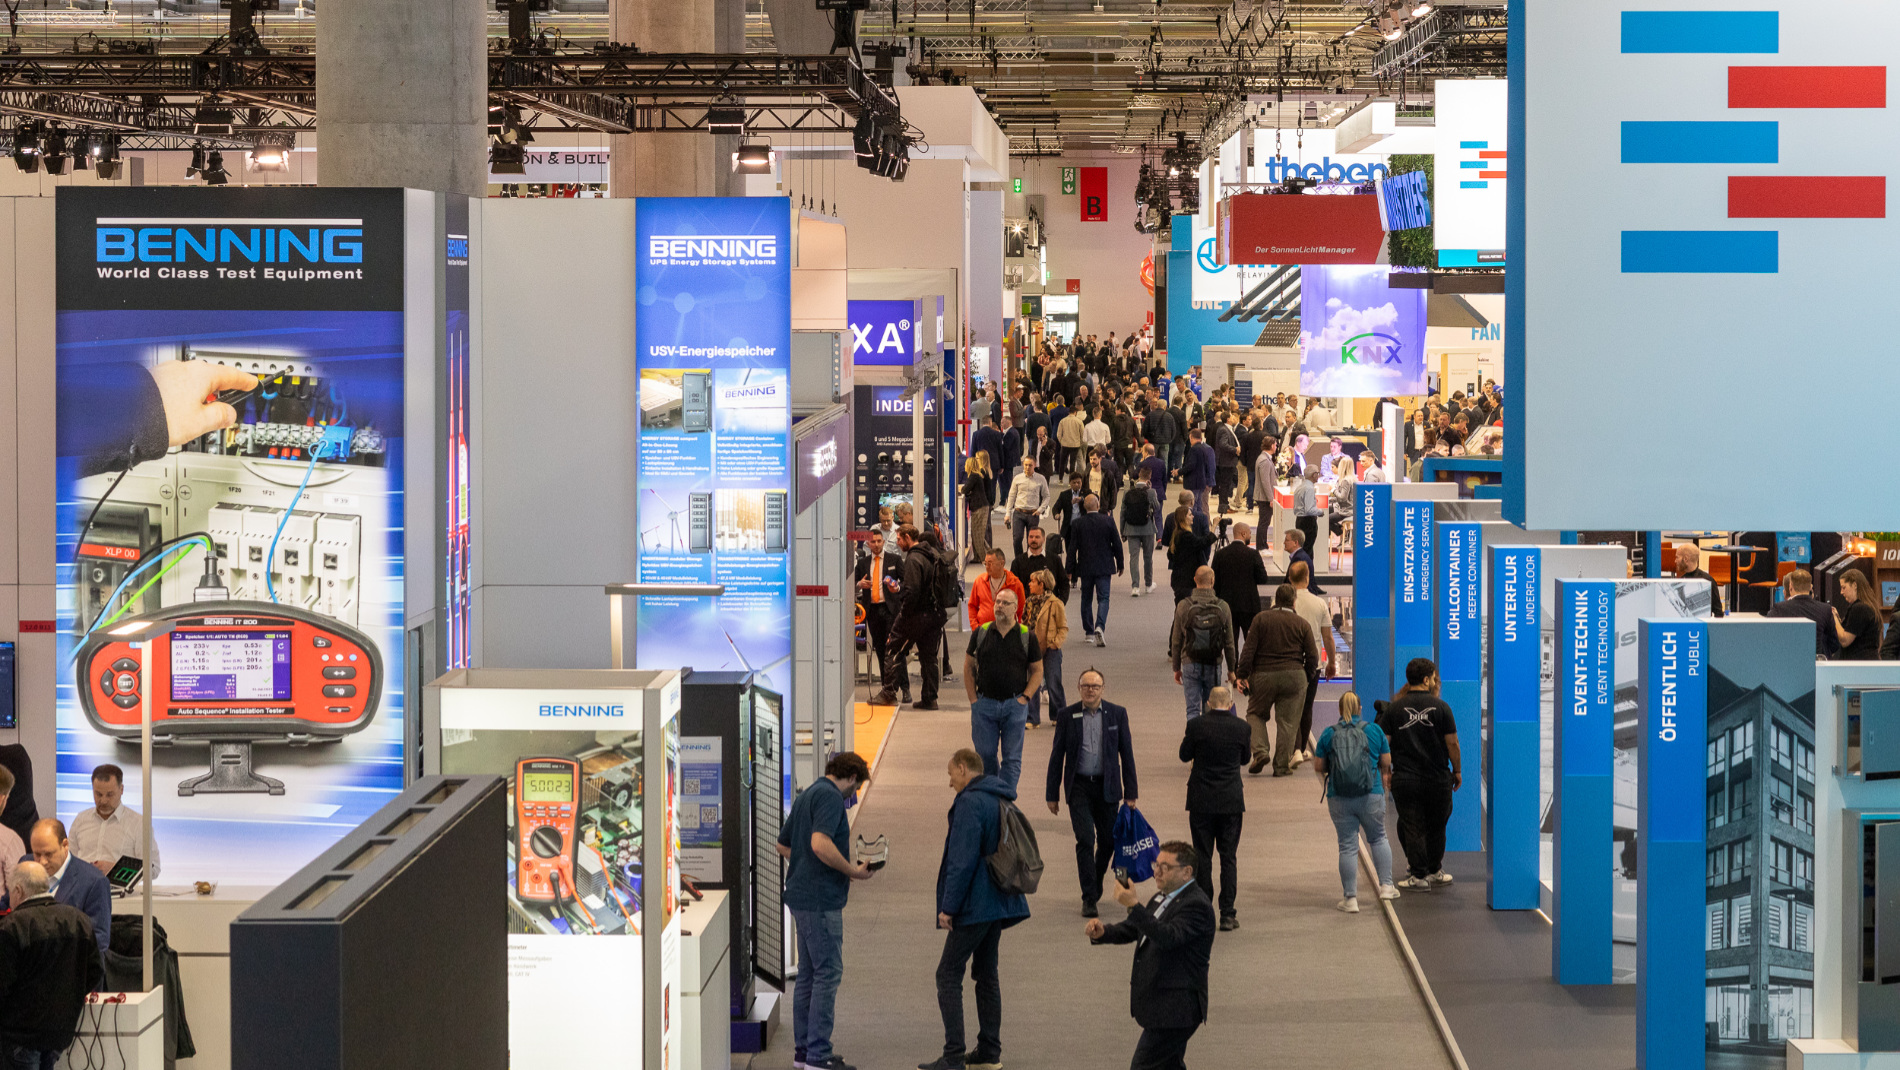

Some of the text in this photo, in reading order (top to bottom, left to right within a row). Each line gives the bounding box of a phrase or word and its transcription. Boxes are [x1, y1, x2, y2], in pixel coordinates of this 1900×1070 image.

[1266, 156, 1388, 184] theben
[1087, 196, 1101, 216] B
[96, 228, 362, 263] BENNING
[650, 240, 776, 258] BENNING
[1270, 246, 1356, 254] SonnenLichtManager
[96, 266, 362, 282] World Class Test Equipment
[650, 345, 776, 358] USV-Energiespeicher
[1341, 346, 1402, 364] KNX
[725, 386, 776, 398] BENNING
[1364, 490, 1374, 548] VARIABOX
[105, 548, 135, 558] XLP 00
[1403, 507, 1414, 602] EINSATZKRÄFTE
[1447, 530, 1460, 640] KÜHLCONTAINER
[1468, 530, 1476, 619] REEFER CONTAINER
[1526, 555, 1535, 624] UNDERFLOOR
[1505, 555, 1517, 642] UNTERFLUR
[1574, 590, 1588, 716] EVENT-TECHNIK
[1598, 590, 1608, 704] EVENT TECHNOLOGY
[1688, 631, 1700, 676] PUBLIC
[1659, 632, 1677, 742] ÖFFENTLICH
[539, 705, 623, 716] BENNING
